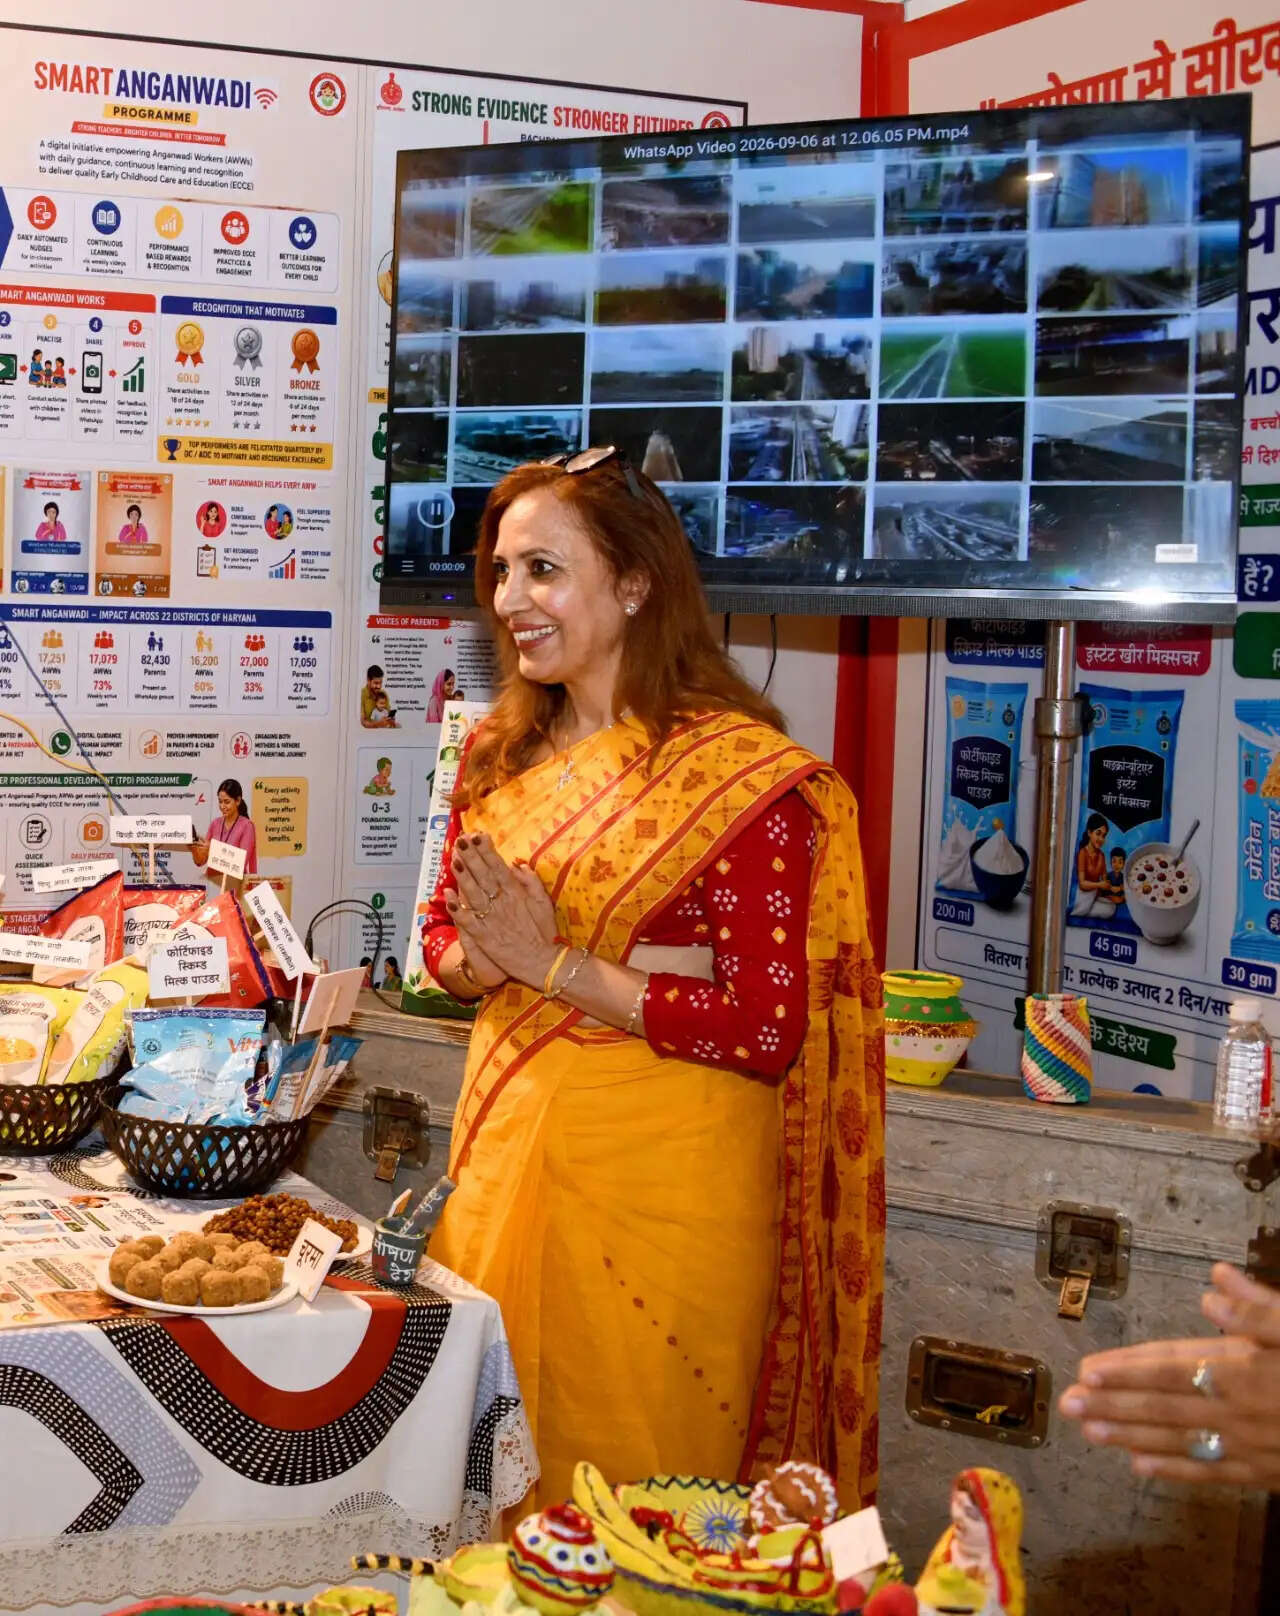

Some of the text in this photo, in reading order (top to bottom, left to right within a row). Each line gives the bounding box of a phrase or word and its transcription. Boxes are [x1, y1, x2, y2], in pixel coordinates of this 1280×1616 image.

[1133, 40, 1176, 100] से
[34, 61, 251, 109] SMART ANGANWADI
[113, 106, 191, 123] PROGRAMME
[412, 91, 472, 117] STRONG
[477, 97, 548, 125] EVIDENCE
[553, 106, 628, 133] STRONGER
[624, 124, 968, 159] WhatsApp Video 2026-09-06 at 12.06.05 PM.mp4
[48, 141, 71, 151] digital
[72, 142, 103, 153] initiative
[105, 147, 151, 158] empowering
[153, 150, 192, 160] Anganwadi
[194, 153, 224, 163] Workers
[40, 153, 244, 178] with daily guidance, continuous learning and recognition
[48, 166, 73, 176] deliver
[74, 168, 100, 179] quality
[101, 170, 119, 181] Early
[121, 172, 158, 183] Childhood
[160, 175, 176, 184] Care
[178, 177, 192, 185] and
[193, 178, 228, 188] Education
[87, 238, 123, 248] CONTINUOUS
[149, 243, 189, 252] PERFORMANCE
[90, 249, 119, 257] LEARNING
[25, 290, 74, 304] ANGANWADI
[76, 293, 105, 305] WORKS
[193, 302, 305, 319] RECOGNITION THAT MOTIVATES
[92, 320, 99, 329] 4
[86, 338, 103, 346] SHARE
[177, 373, 200, 383] GOLD
[234, 376, 261, 388] SILVER
[290, 379, 321, 391] BRONZE
[208, 478, 227, 486] SMART
[229, 479, 264, 488] ANGANWADI
[430, 562, 465, 571] 00:00:09
[12, 608, 256, 623] SMART ANGANWADI IMPACT ACROSS 22 DISTRICTS OF HARYANA
[376, 617, 399, 625] VOICES
[39, 653, 65, 664] 17,251
[89, 654, 118, 665] 17,079
[1017, 647, 1046, 660] पाउड
[1118, 643, 1144, 664] खीर
[141, 655, 170, 666] 82,430
[191, 655, 219, 667] 16,200
[240, 657, 269, 668] 27,000
[290, 657, 317, 669] 17,050
[93, 681, 112, 691] 73%
[194, 681, 213, 691] 60%
[244, 682, 263, 692] 33%
[293, 683, 311, 693] 27%
[10, 777, 61, 785] PROFESSIONAL
[116, 776, 134, 785] (TPD)
[136, 777, 180, 785] PROGRAMME
[936, 903, 970, 921] 200 ml
[1095, 937, 1132, 957] 45 gm
[984, 944, 1022, 970] वितरण
[164, 974, 220, 987] मिल्क पाउडर
[1228, 965, 1272, 988] 30 gm
[1079, 967, 1119, 992] प्रत्येक
[1122, 977, 1161, 1004] उत्पाद
[1165, 988, 1173, 1005] 2
[375, 1233, 416, 1264] पोषण
